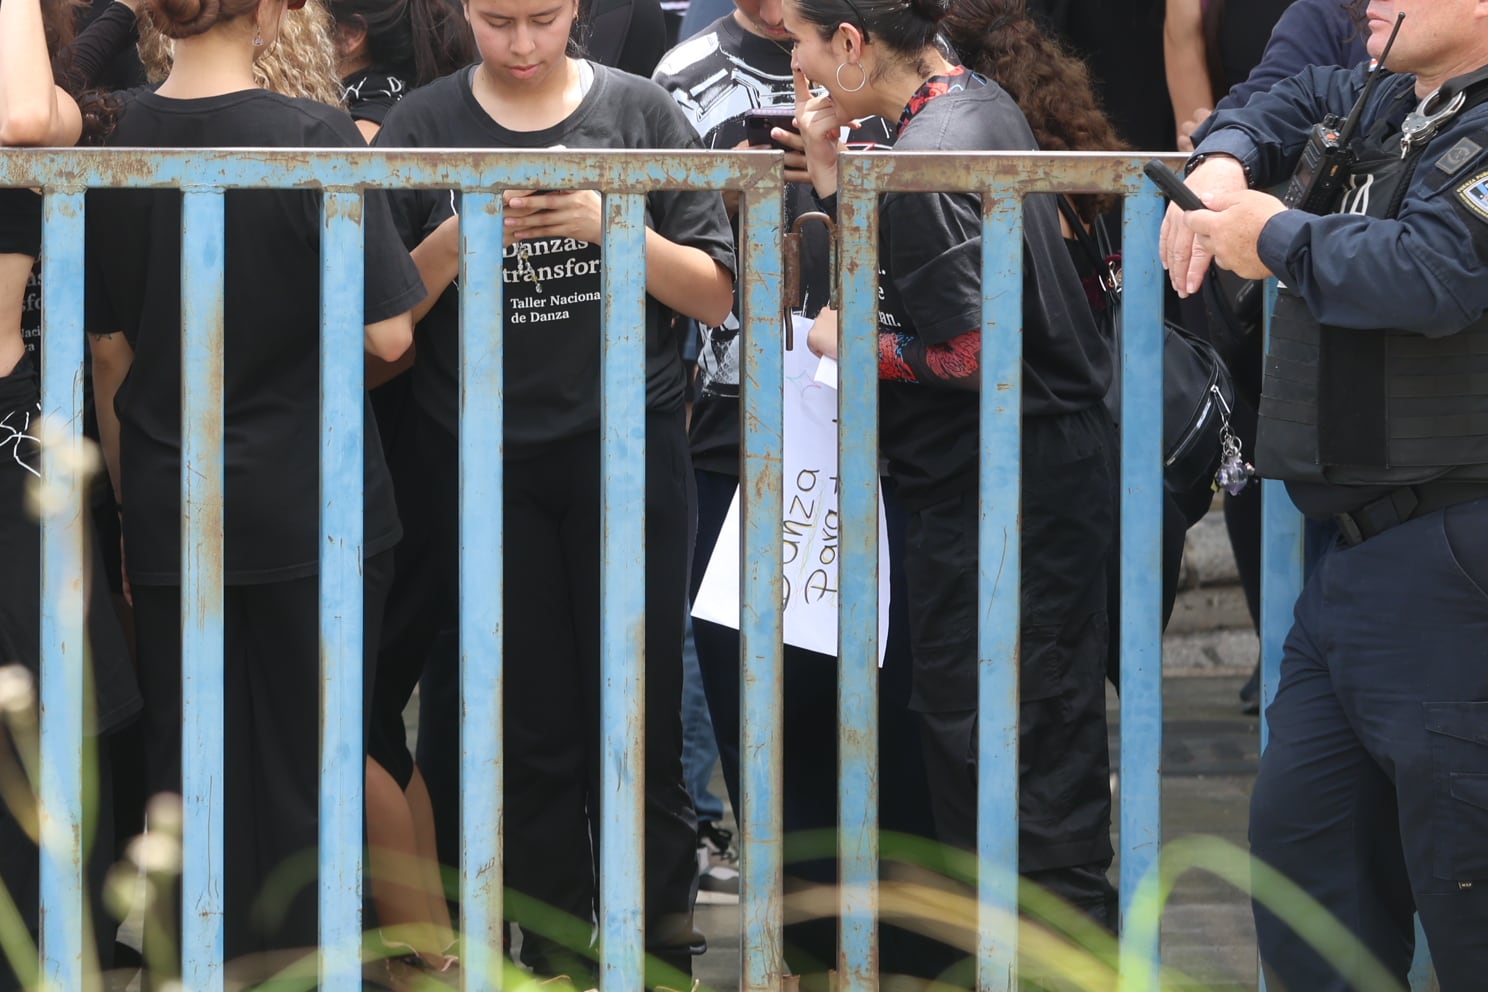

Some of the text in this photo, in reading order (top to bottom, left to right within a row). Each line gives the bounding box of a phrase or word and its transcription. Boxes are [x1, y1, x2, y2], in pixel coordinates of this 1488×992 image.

[503, 257, 602, 283] transfor
[510, 291, 602, 310] Taller Naciona
[511, 310, 570, 324] de Danza
